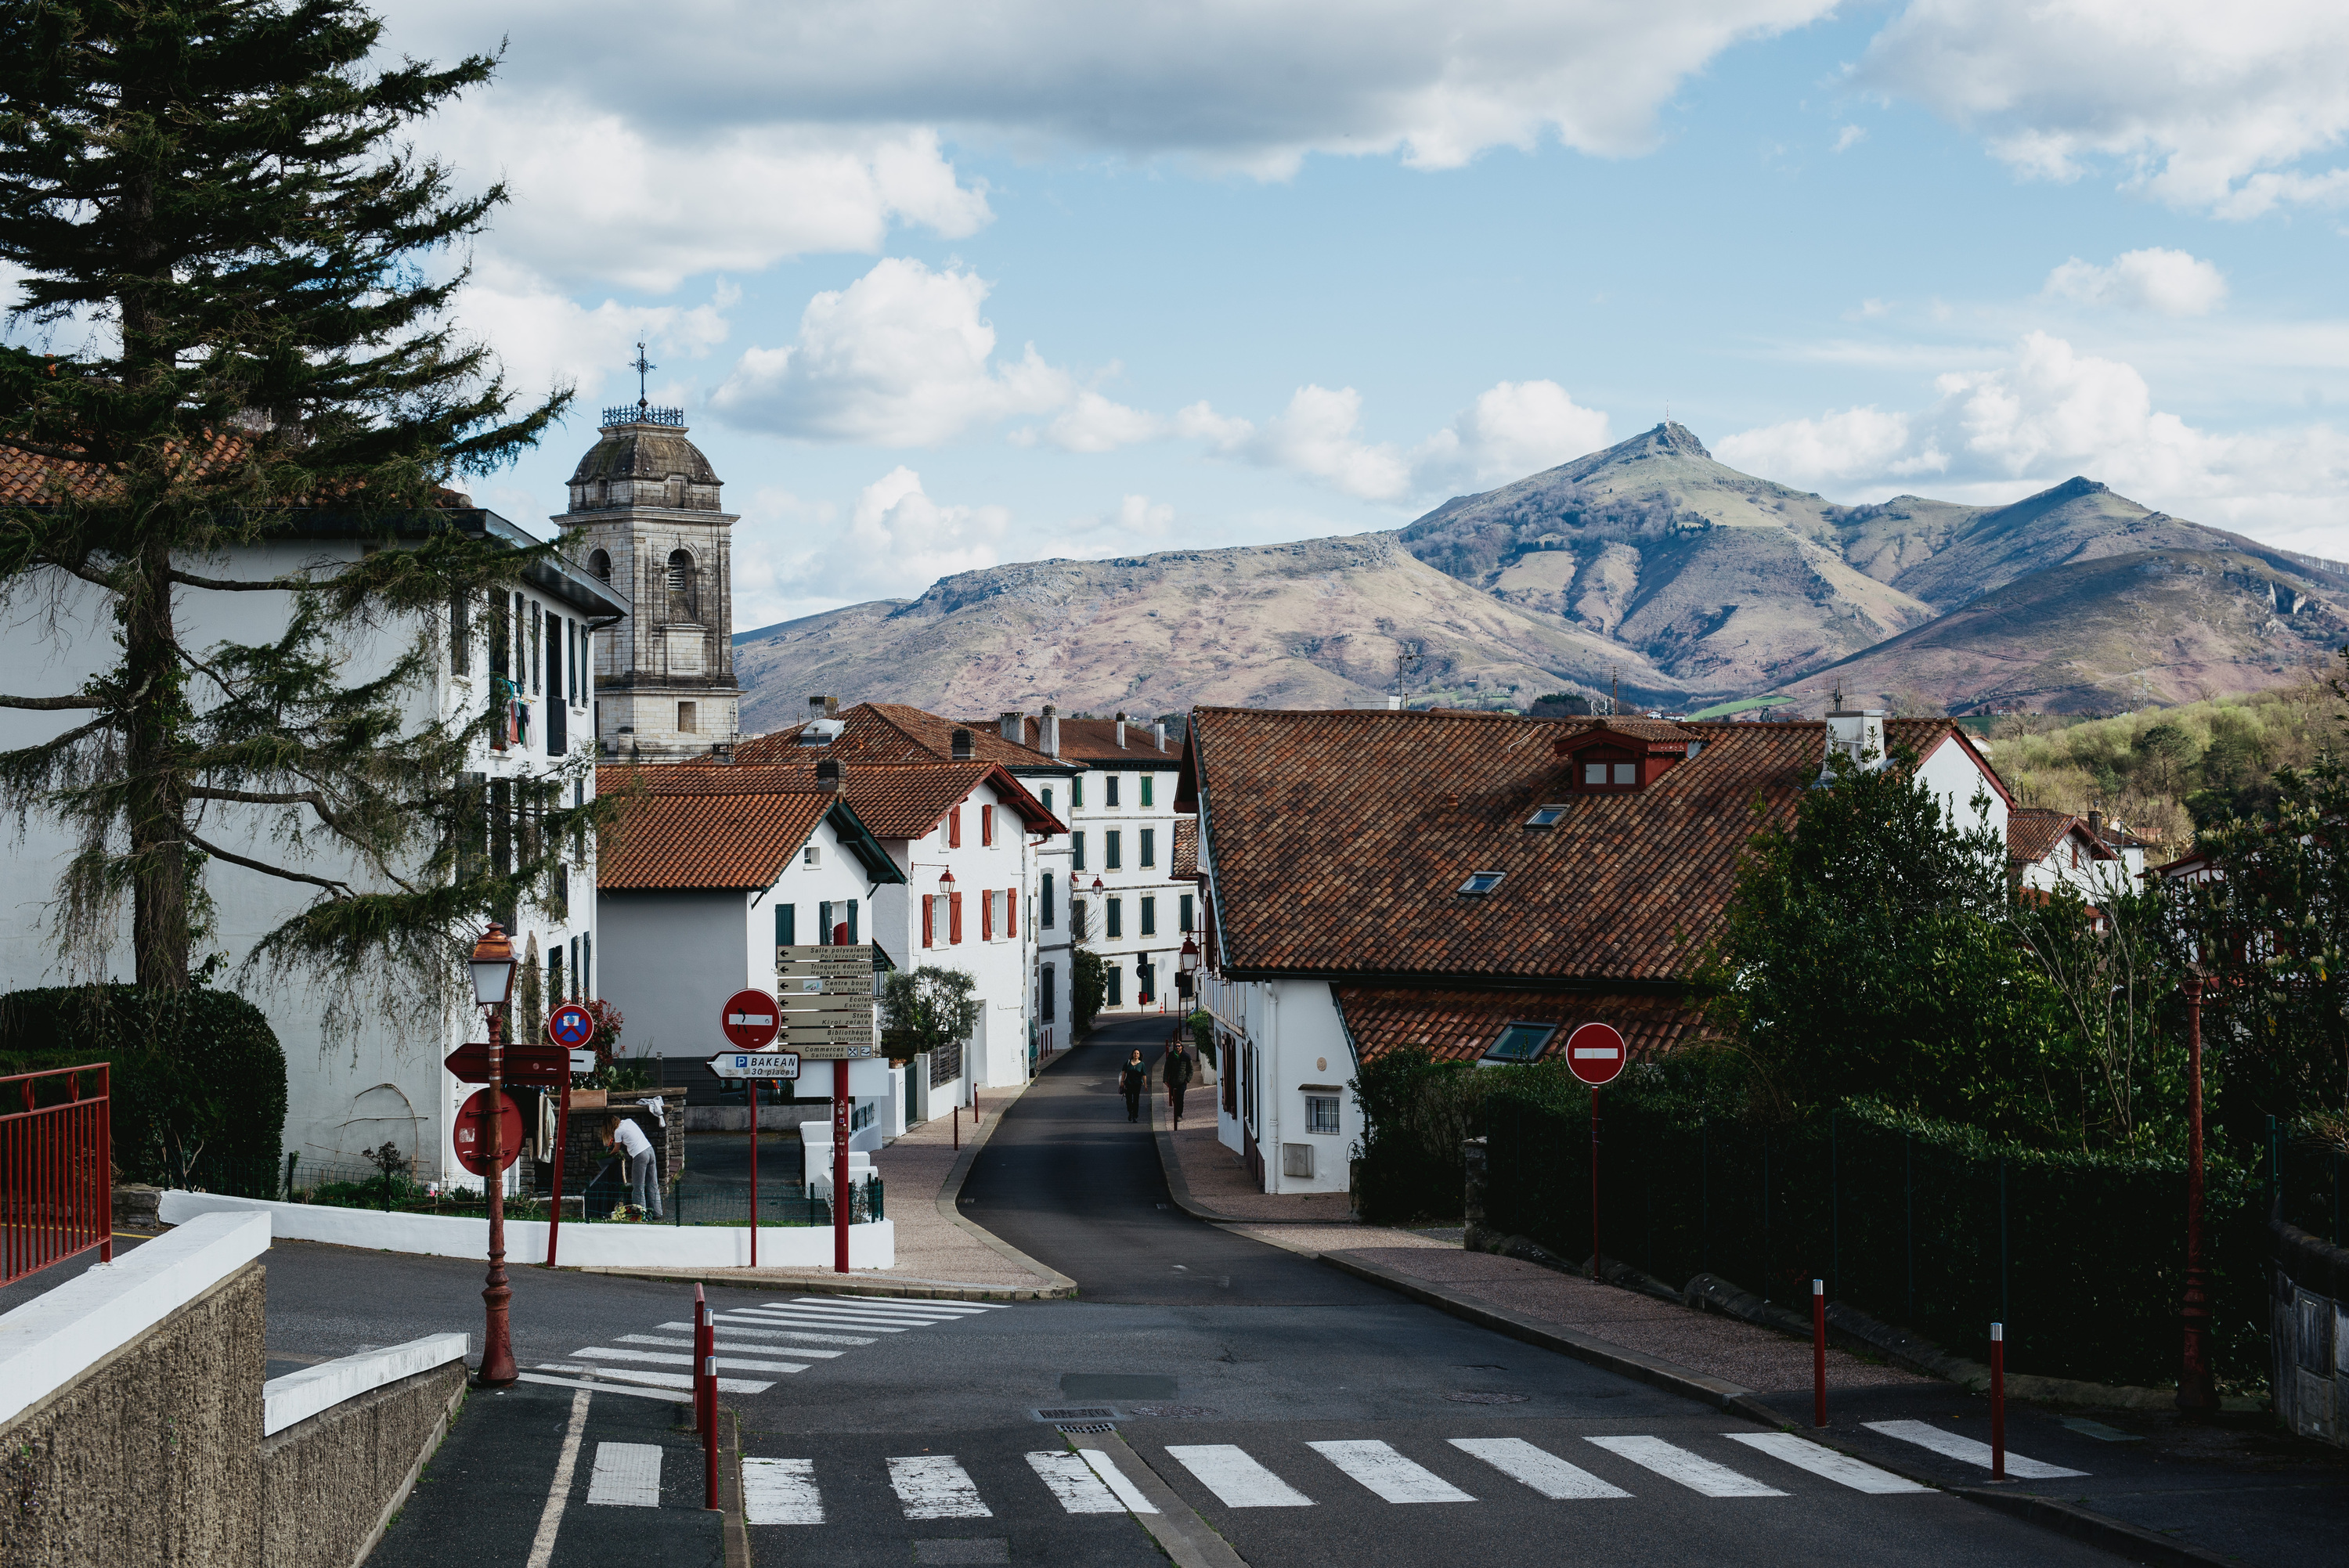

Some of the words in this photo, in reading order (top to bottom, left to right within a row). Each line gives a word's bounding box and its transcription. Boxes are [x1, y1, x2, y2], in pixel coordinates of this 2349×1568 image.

[738, 1058, 745, 1066] P
[751, 1058, 796, 1066] BAKEAN
[767, 1068, 795, 1076] places
